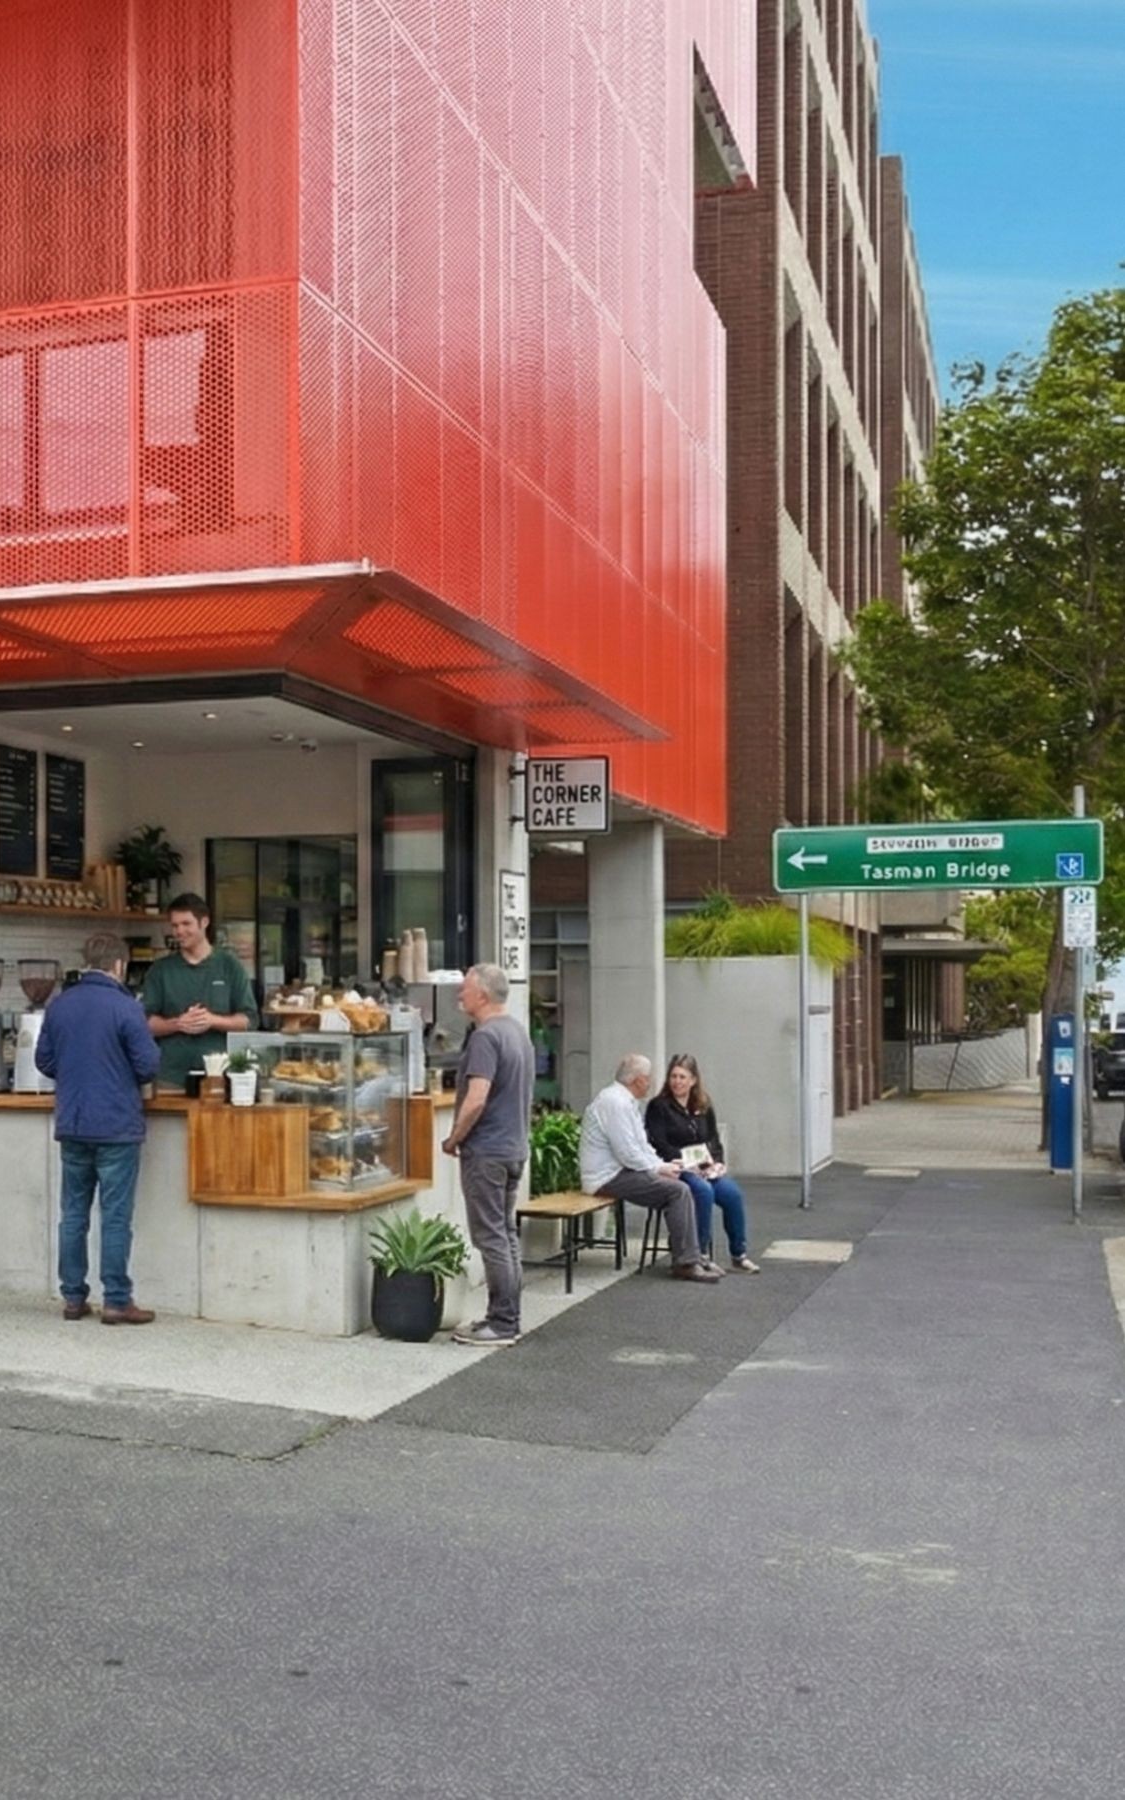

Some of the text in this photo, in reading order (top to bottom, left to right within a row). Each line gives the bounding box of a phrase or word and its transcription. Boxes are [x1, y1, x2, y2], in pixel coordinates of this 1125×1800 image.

[532, 763, 565, 783] THE
[532, 785, 601, 804] CORNER
[532, 807, 576, 826] CAFE
[861, 861, 1011, 880] Tasman Bridge
